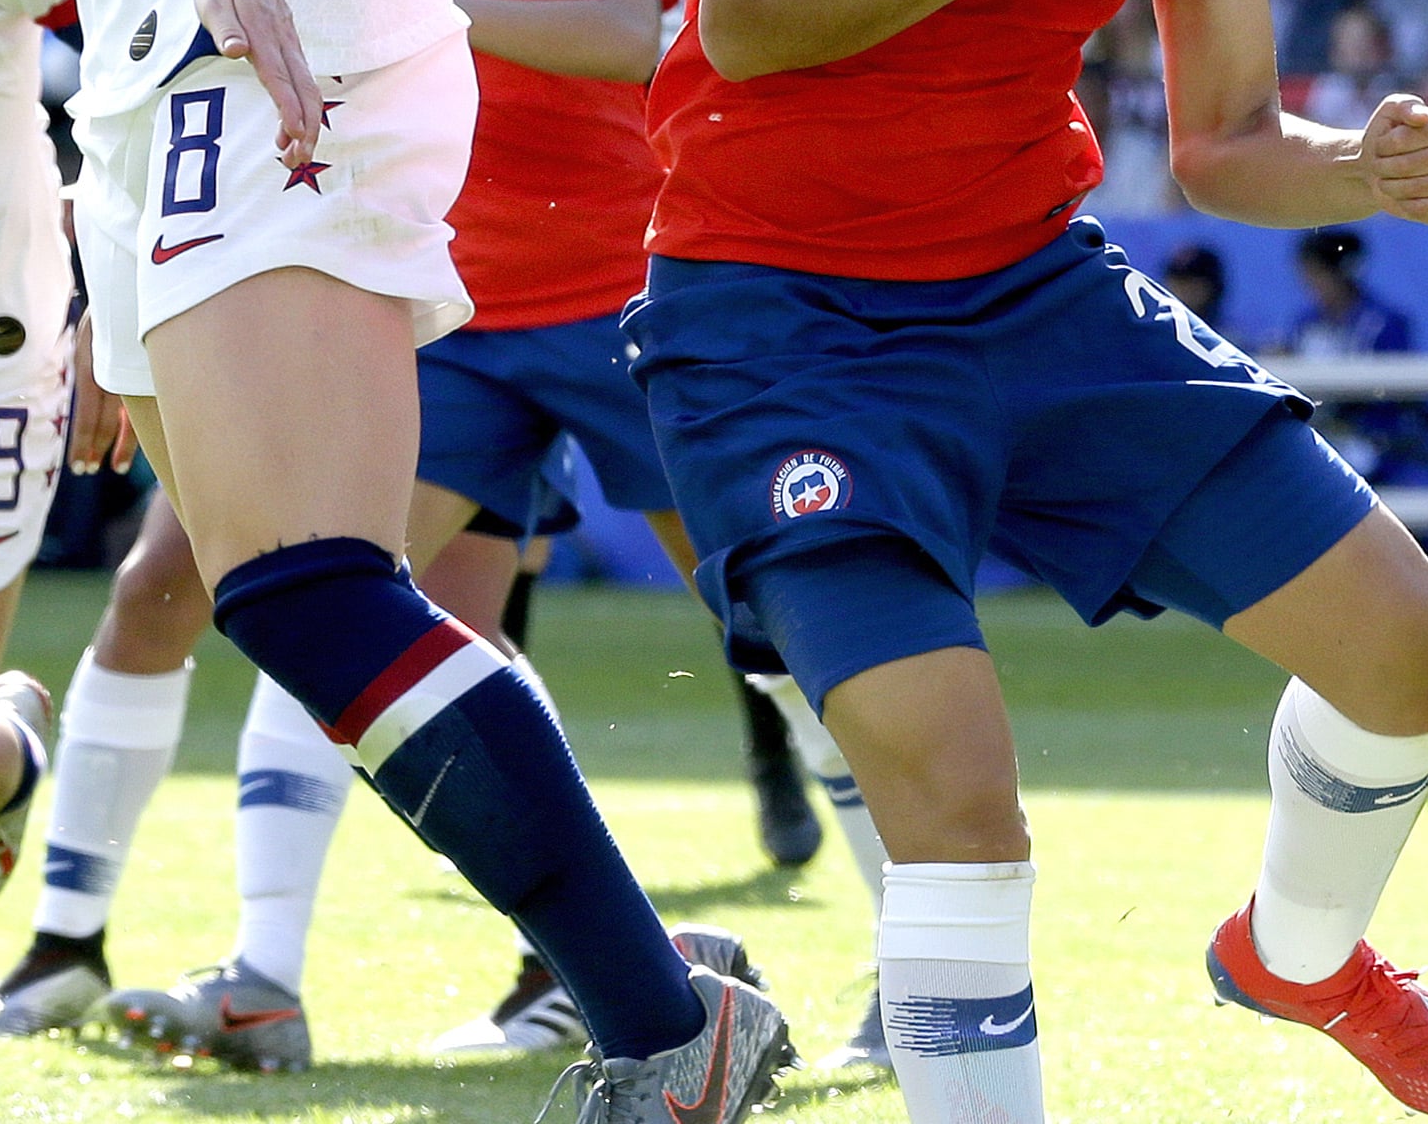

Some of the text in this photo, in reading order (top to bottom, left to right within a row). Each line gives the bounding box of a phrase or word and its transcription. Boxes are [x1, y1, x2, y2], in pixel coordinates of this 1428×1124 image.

[162, 87, 226, 218] 8
[803, 453, 815, 463] DE
[819, 455, 847, 481] FUTBOL
